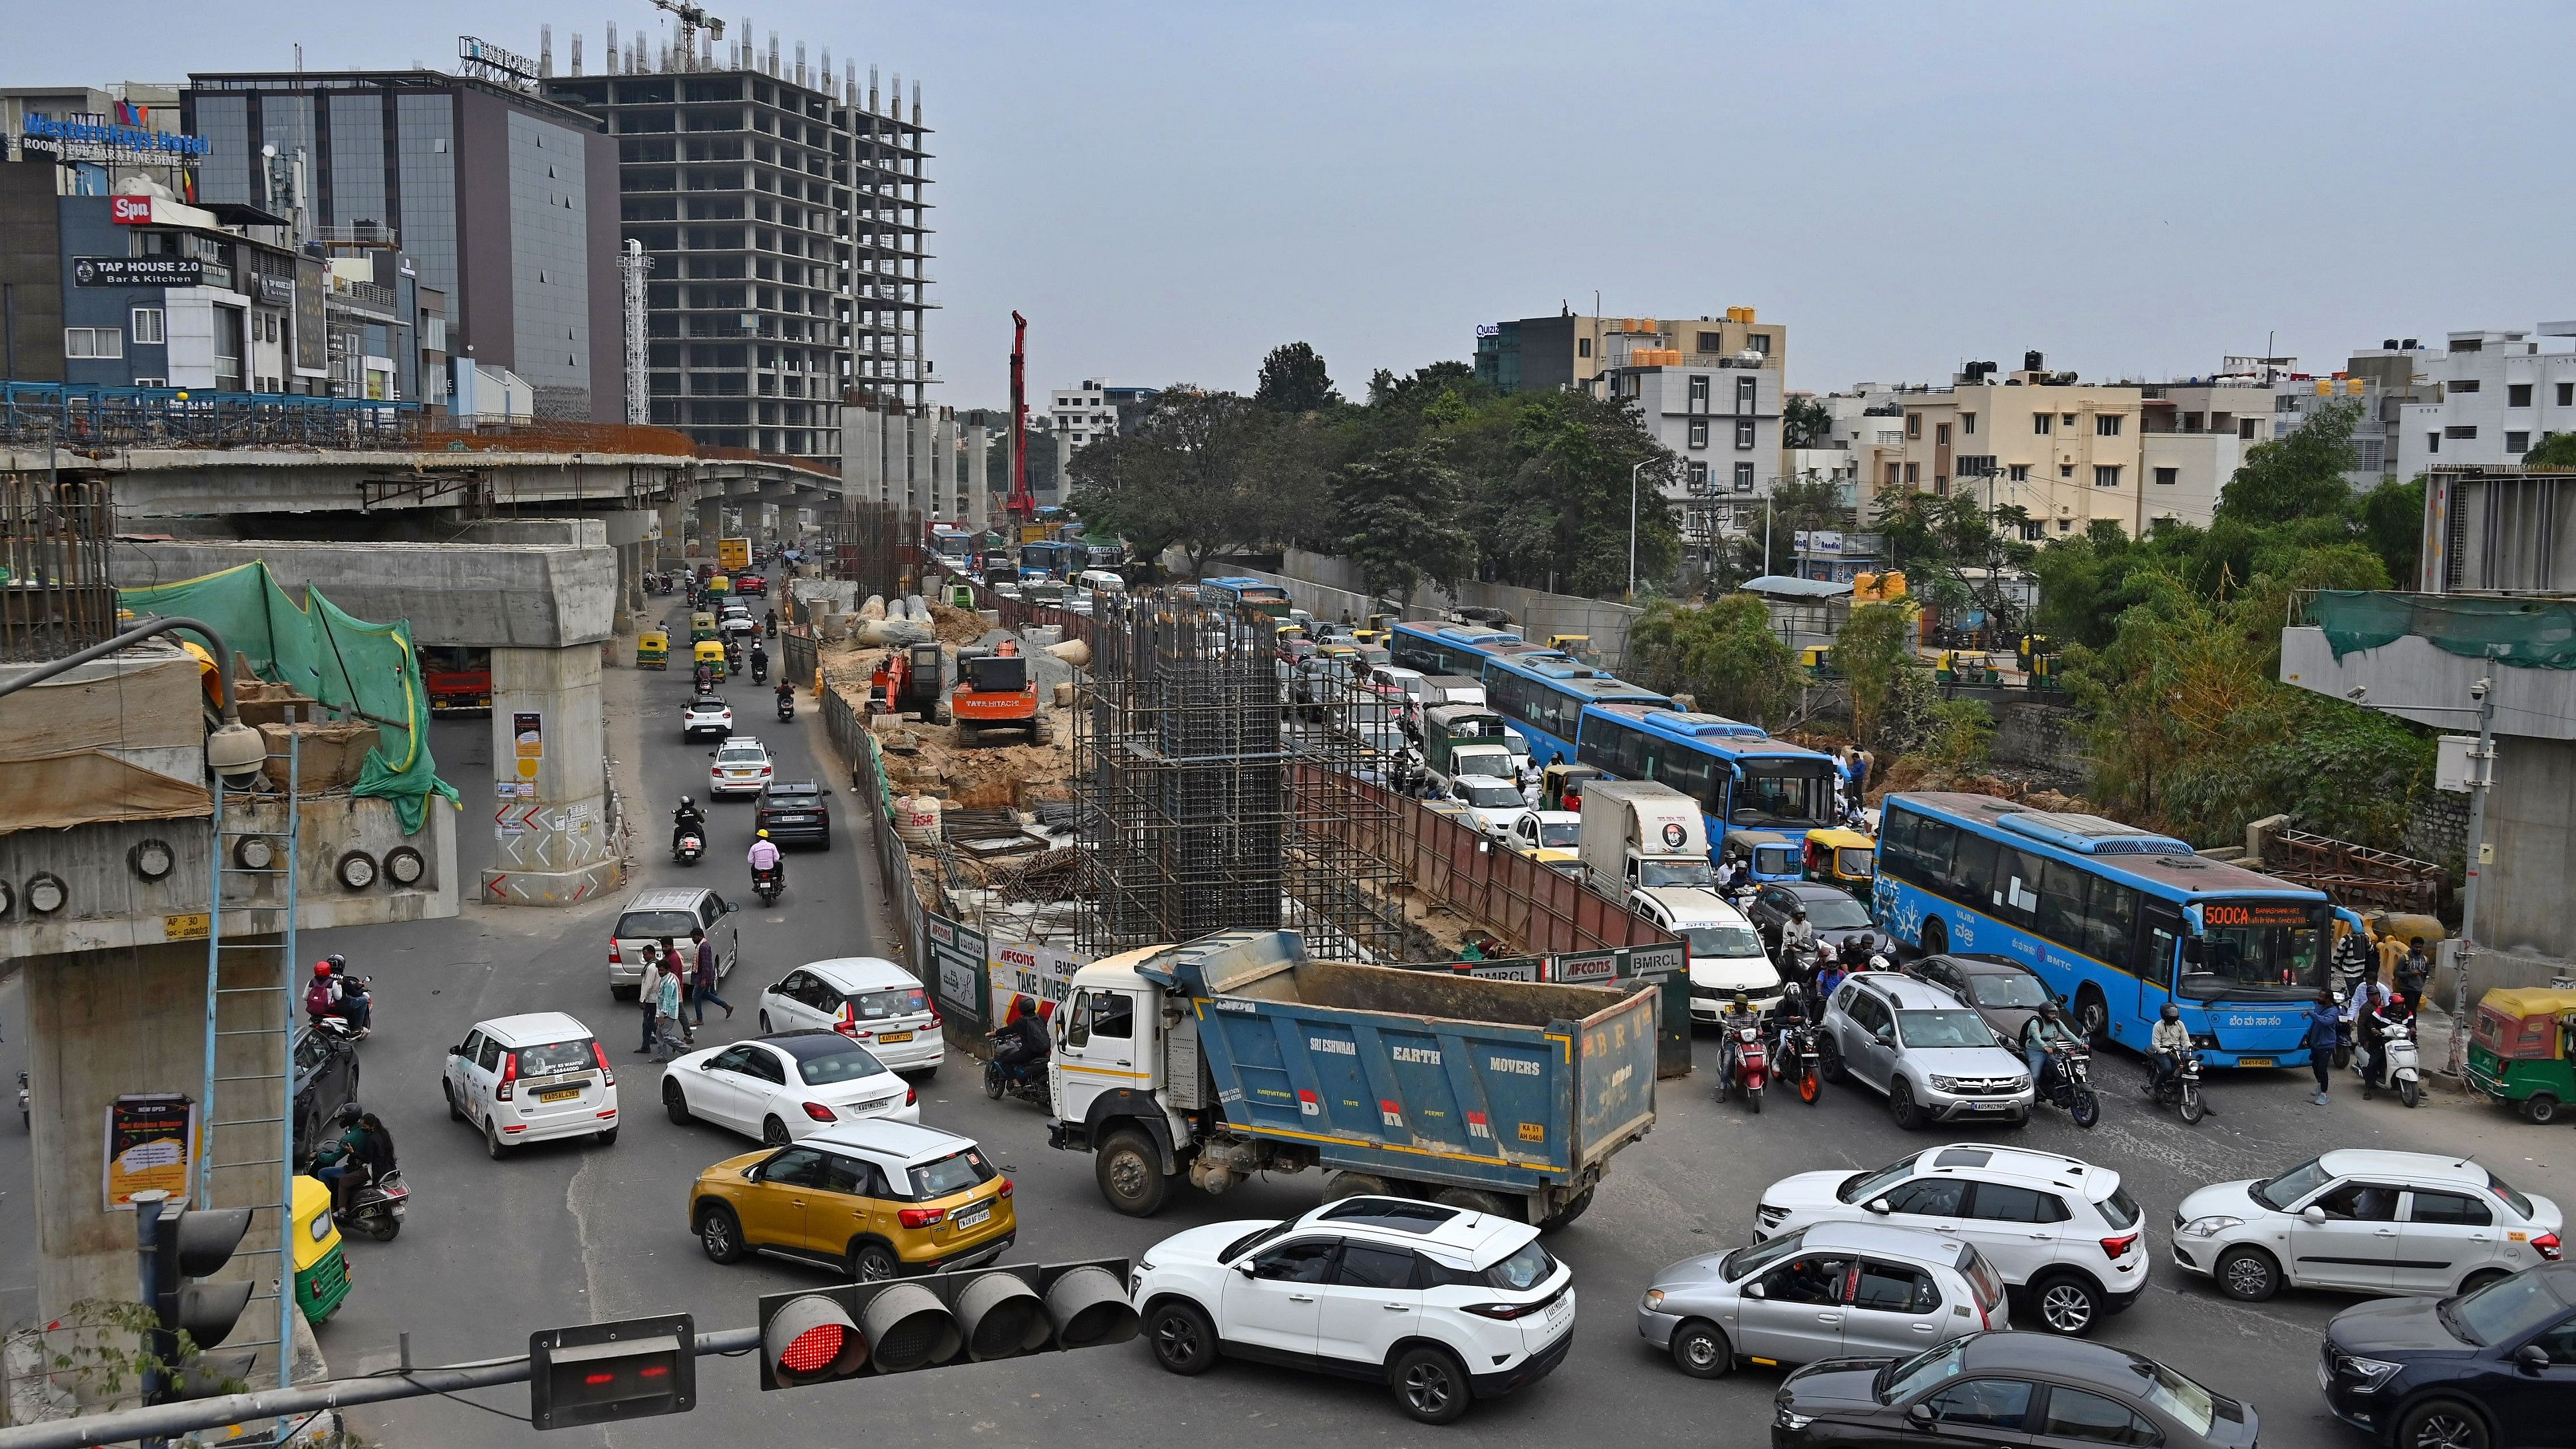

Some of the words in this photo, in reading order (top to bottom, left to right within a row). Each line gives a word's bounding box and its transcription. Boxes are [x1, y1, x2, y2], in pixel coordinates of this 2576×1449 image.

[159, 130, 210, 155] Hotel
[24, 138, 65, 154] ROOMS
[127, 153, 150, 164] FINE
[154, 155, 180, 166] DINE
[116, 199, 149, 220] Spa
[200, 251, 217, 264] OUNGE
[96, 262, 123, 272] TAP
[128, 262, 175, 272] HOUSE
[179, 262, 200, 272] 2.0
[143, 275, 192, 283] Kitchen
[1821, 541, 1841, 549] Nandini
[912, 814, 933, 826] HSR
[188, 916, 198, 926] 30
[1956, 910, 1975, 924] VAJRA
[2206, 906, 2249, 924] 500CA
[932, 924, 951, 942] AFCONS
[1000, 950, 1035, 967] AFCONS
[1633, 954, 1679, 971] BMRCL
[2047, 955, 2072, 971] BMTC
[1567, 960, 1612, 977] AFCONS
[1016, 970, 1038, 995] TAKE
[2229, 1015, 2242, 1025] ಬೆಂ
[2244, 1017, 2253, 1025] ಮ
[2255, 1017, 2267, 1025] ಸಾ
[2268, 1015, 2281, 1025] ಸಂ
[1310, 1037, 1322, 1051] SRI
[1322, 1039, 1356, 1056] ESHWARA
[1393, 1046, 1441, 1065] EARTH
[1490, 1057, 1540, 1077] MOVERS
[1256, 1088, 1291, 1099] KARNATAKA
[1298, 1089, 1320, 1117] B
[1379, 1099, 1403, 1128] R
[1467, 1111, 1490, 1138] M
[1528, 1132, 1542, 1142] 0463
